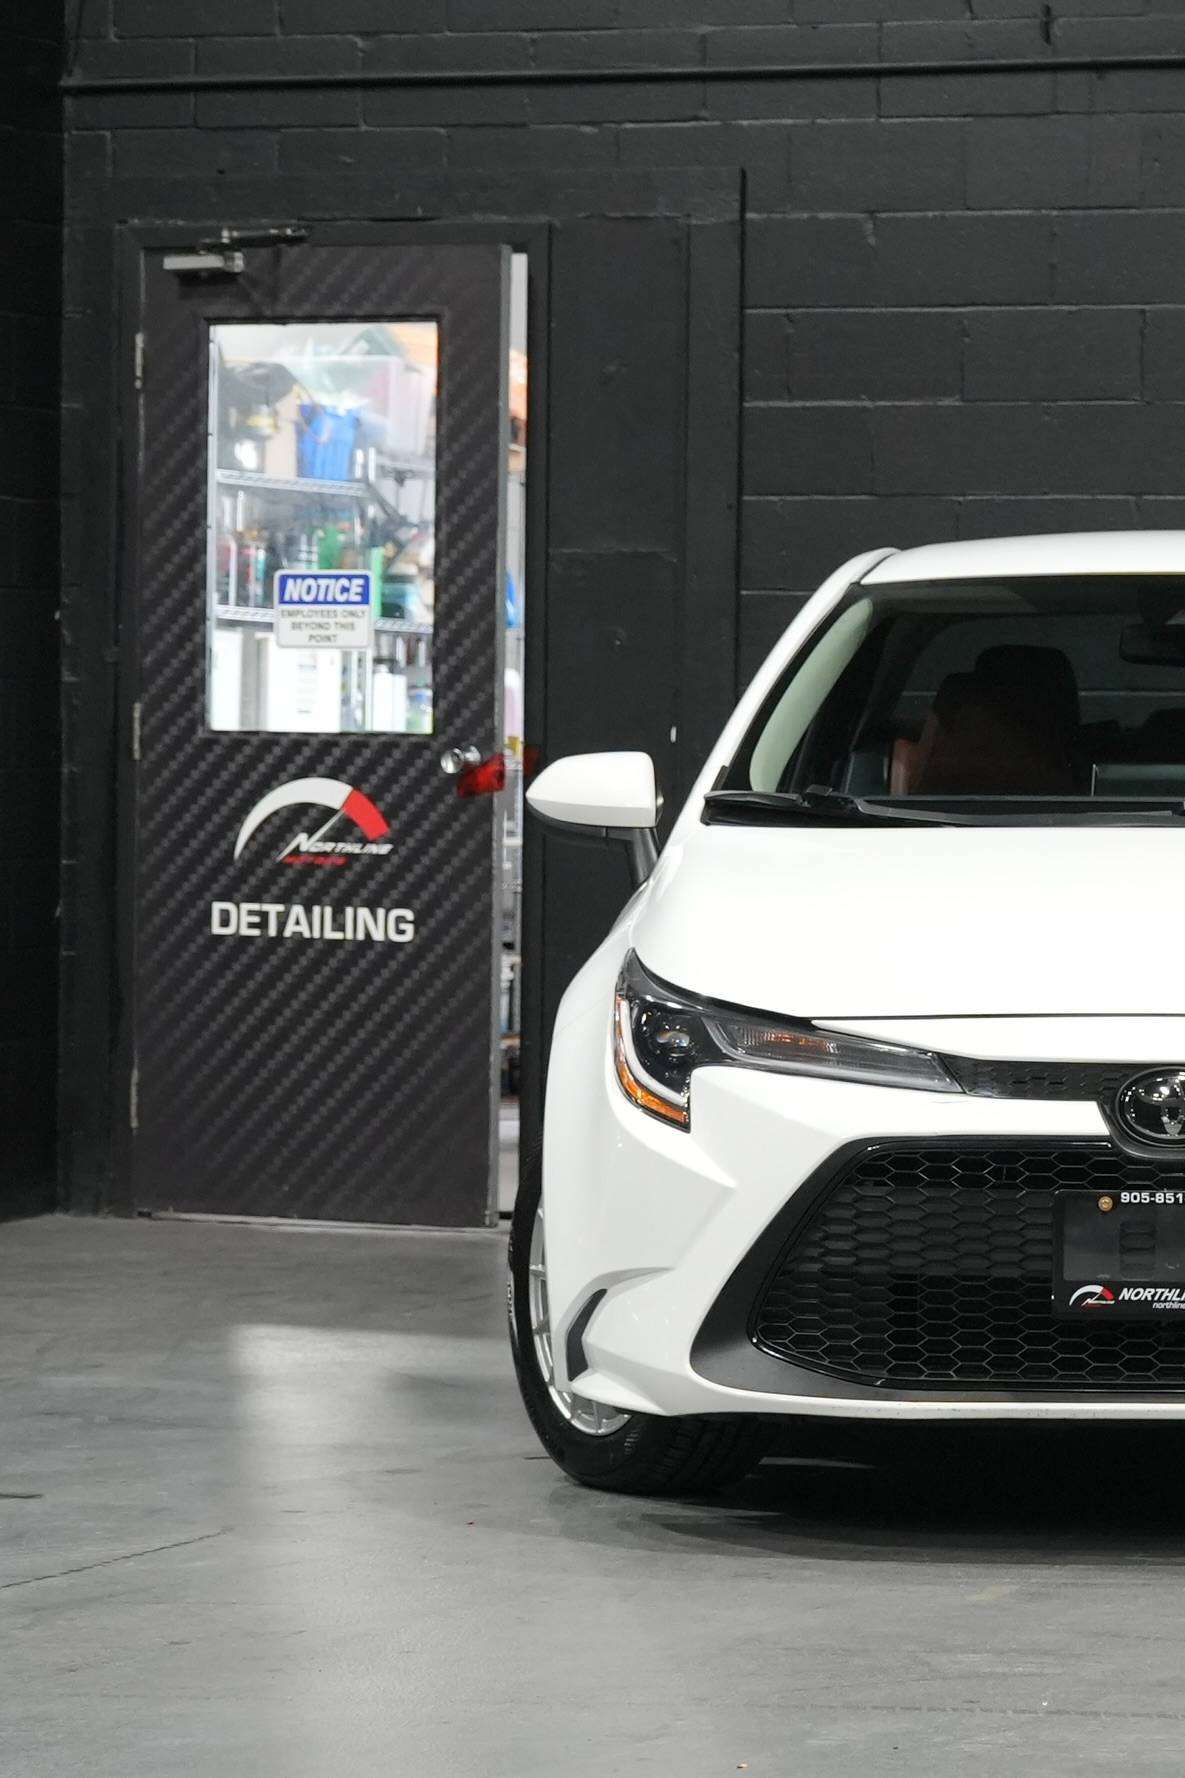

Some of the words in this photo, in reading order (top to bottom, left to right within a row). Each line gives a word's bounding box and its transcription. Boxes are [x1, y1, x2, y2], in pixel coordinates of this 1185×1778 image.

[283, 577, 364, 602] NOTICE
[281, 609, 338, 618] EMPLOYEES
[341, 610, 366, 618] ONLY
[291, 621, 331, 631] BEYOND
[334, 621, 355, 631] THIS
[308, 634, 337, 643] POINT
[211, 901, 415, 943] DETAILING
